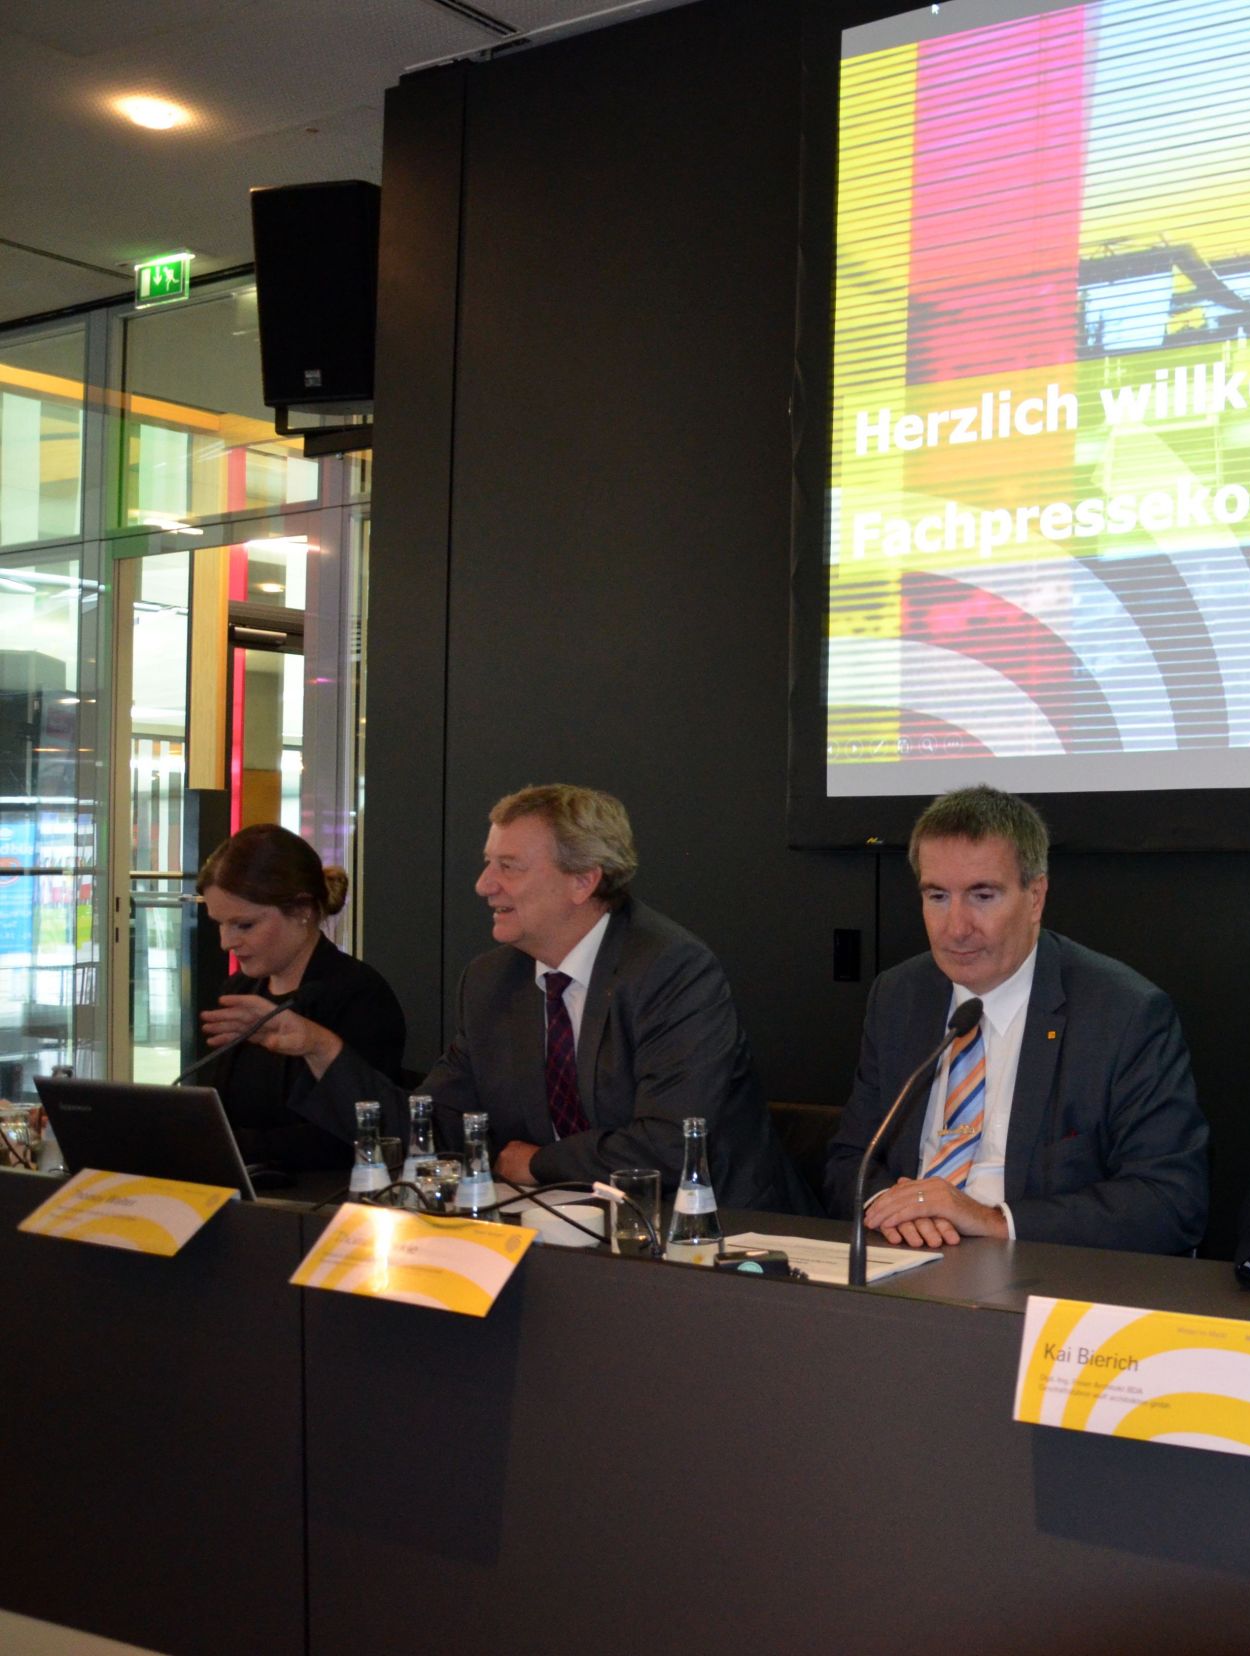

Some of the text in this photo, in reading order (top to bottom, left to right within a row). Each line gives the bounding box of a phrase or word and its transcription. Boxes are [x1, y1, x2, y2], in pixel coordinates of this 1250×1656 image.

[855, 386, 1078, 456] Herzlich
[1044, 1343, 1139, 1372] Kai Bierich
